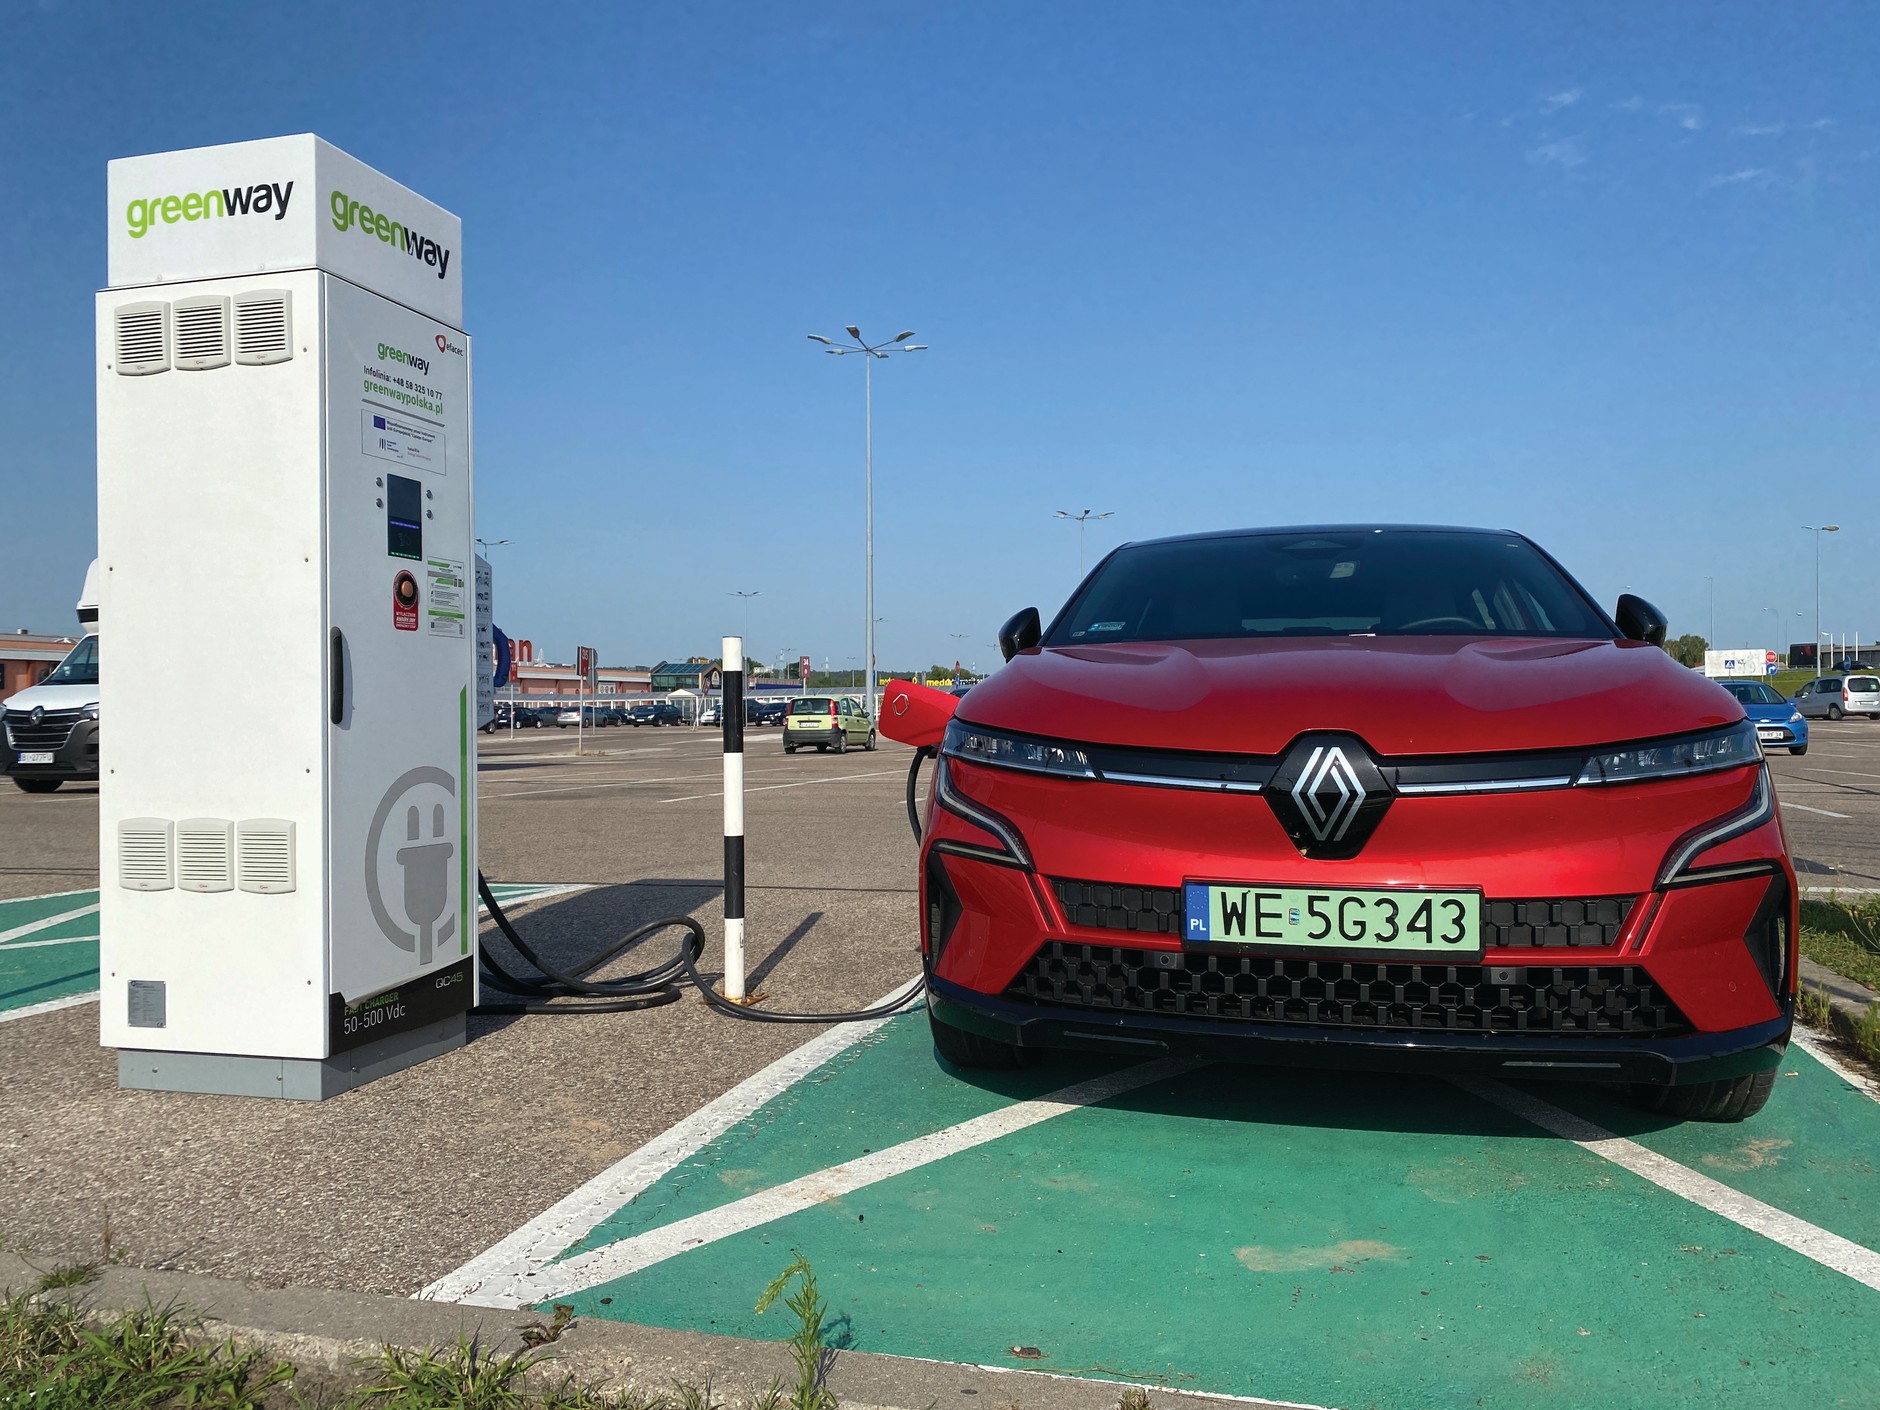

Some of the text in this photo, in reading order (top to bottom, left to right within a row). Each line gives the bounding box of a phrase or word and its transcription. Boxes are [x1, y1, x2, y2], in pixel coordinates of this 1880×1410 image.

[126, 181, 293, 238] greenway
[330, 190, 450, 280] greenway
[377, 342, 430, 376] greenway
[446, 342, 464, 357] efacec
[363, 365, 443, 401] Infolinia: +48 58 325 10 77
[363, 379, 443, 416] greenwaypolska.pl
[803, 658, 809, 666] 34
[1190, 918, 1207, 931] PL
[1221, 891, 1467, 944] WE 5G343
[435, 972, 463, 989] QC45
[364, 991, 399, 1009] CHARGER
[344, 1003, 406, 1035] 50-500 Vdc
